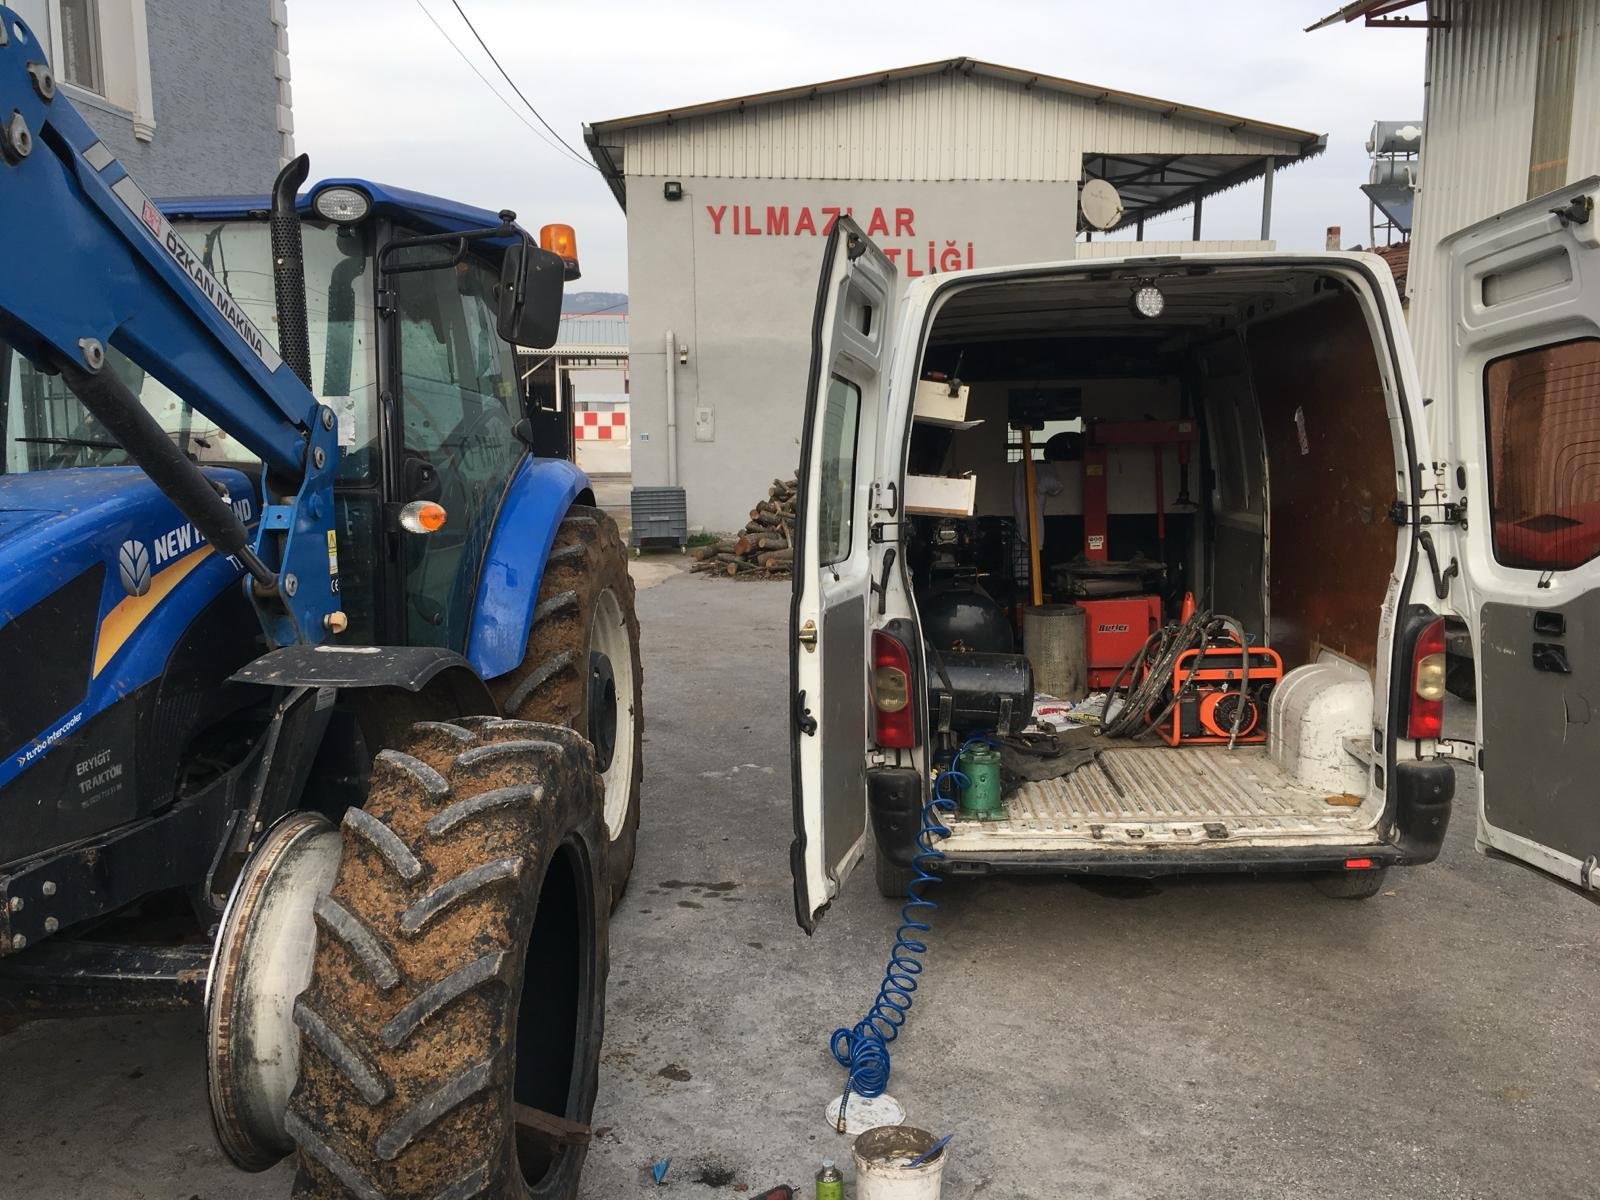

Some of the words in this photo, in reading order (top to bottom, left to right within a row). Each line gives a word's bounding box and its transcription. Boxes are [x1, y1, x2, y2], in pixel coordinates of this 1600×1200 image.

[706, 205, 916, 237] YILMAZAR
[883, 240, 975, 278] TLİĞİ
[166, 229, 215, 300] ÖZKAN
[216, 290, 264, 358] MAKİNA
[154, 522, 192, 566] NEW
[25, 741, 48, 761] turbo
[46, 712, 83, 745] intercooler
